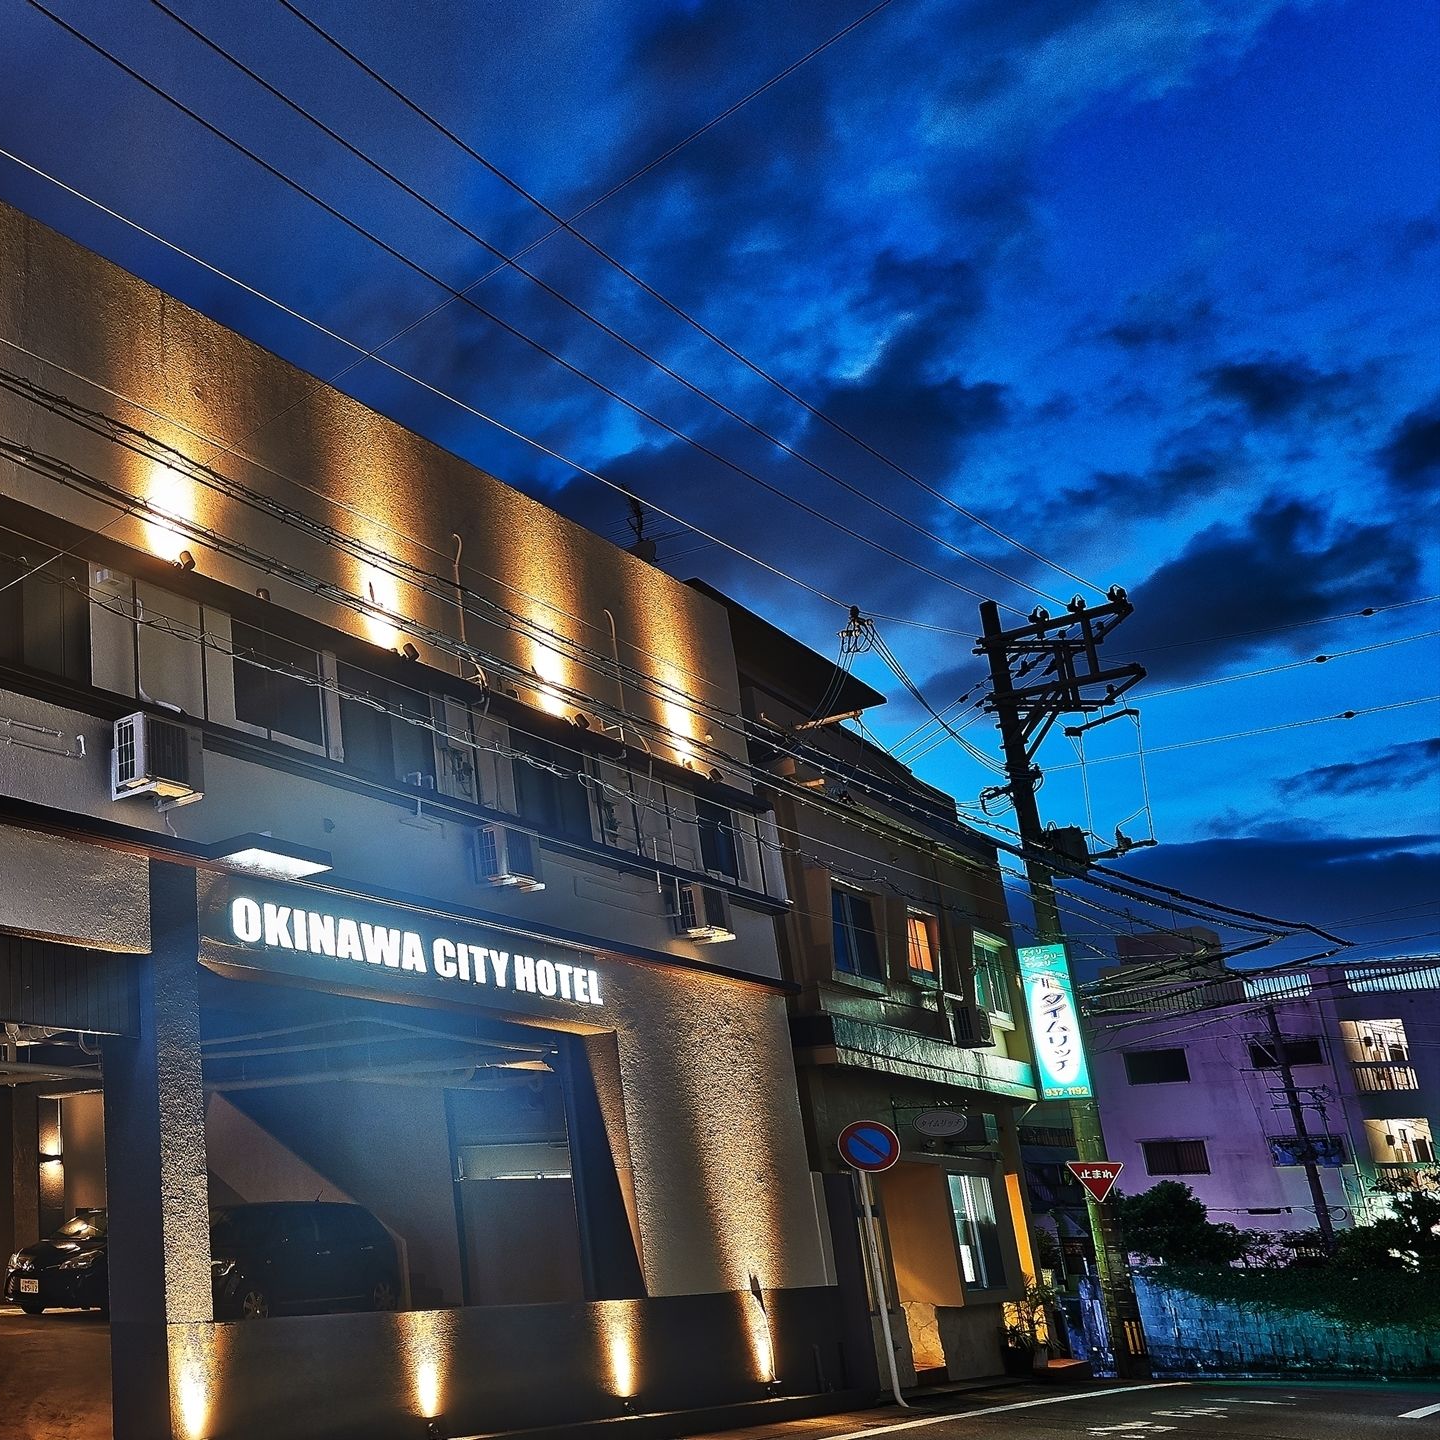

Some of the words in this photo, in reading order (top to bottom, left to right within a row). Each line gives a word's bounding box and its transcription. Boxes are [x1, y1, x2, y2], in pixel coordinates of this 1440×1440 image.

[231, 897, 428, 974] OKINAWA
[432, 938, 510, 988] CITY
[514, 954, 604, 1006] HOTEL
[1080, 1169, 1115, 1179] 止まれ
